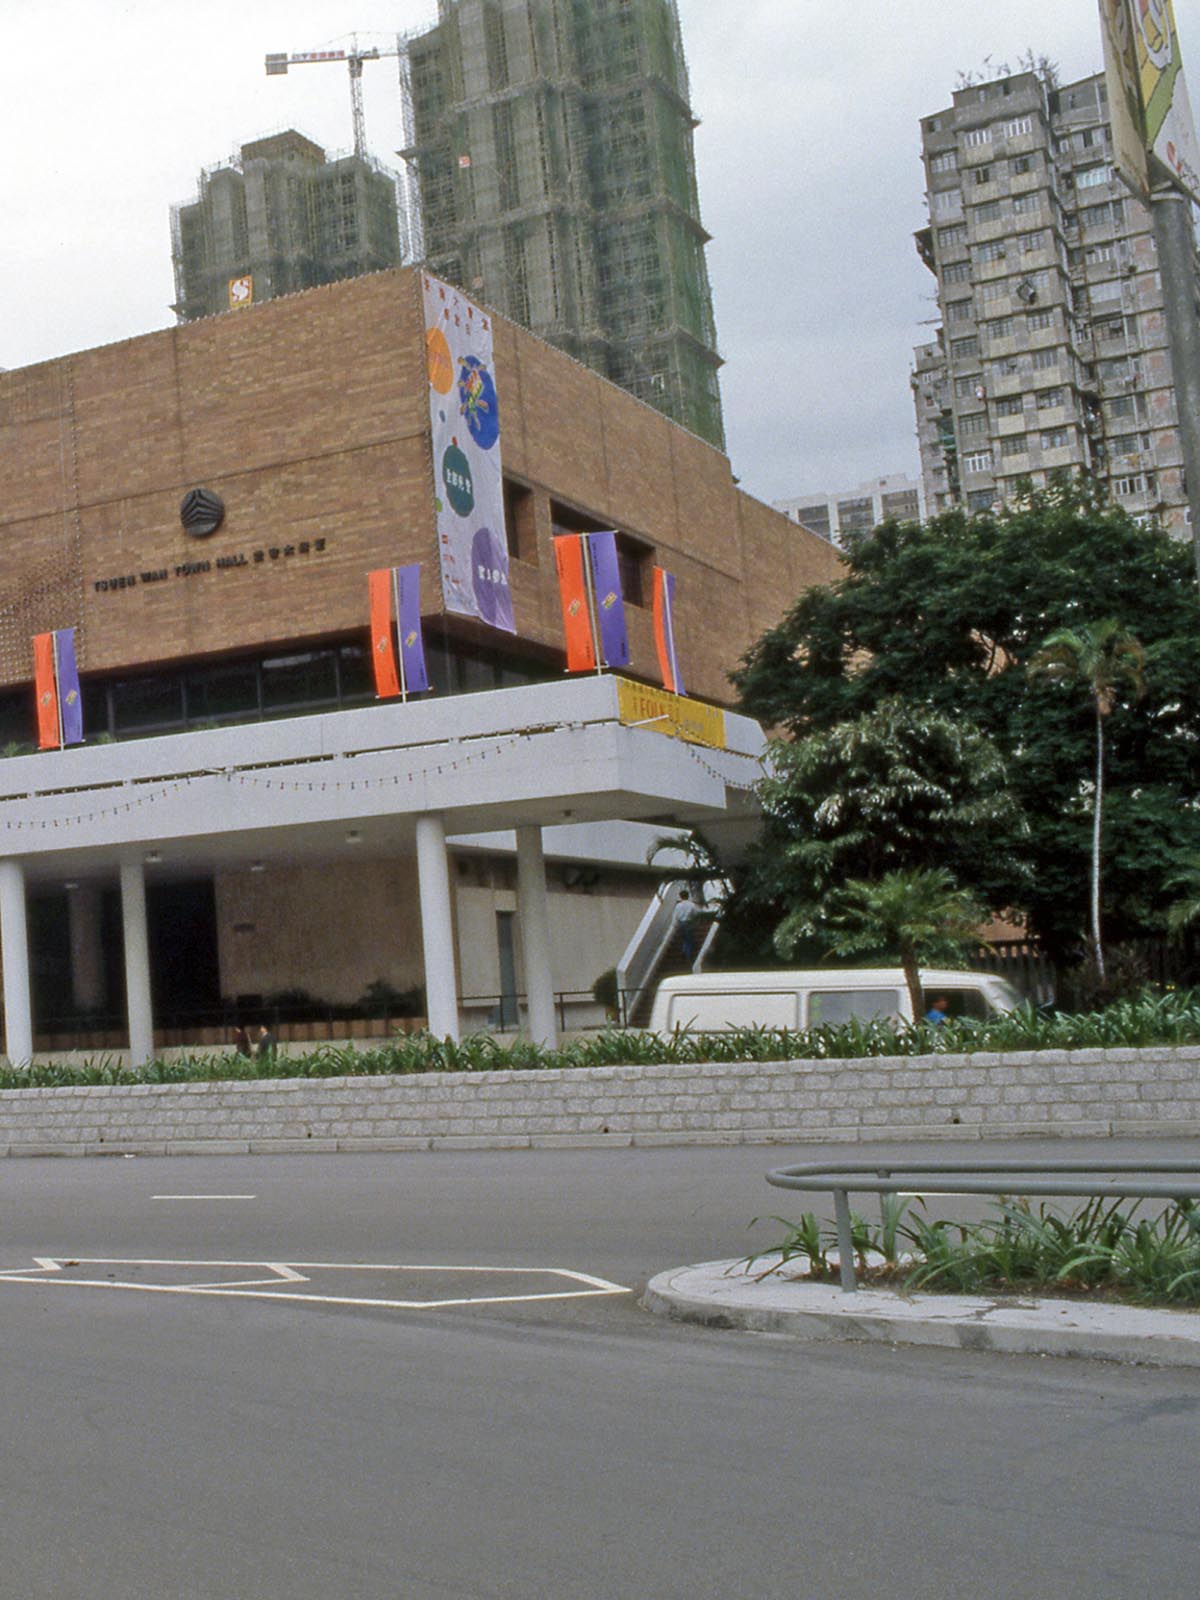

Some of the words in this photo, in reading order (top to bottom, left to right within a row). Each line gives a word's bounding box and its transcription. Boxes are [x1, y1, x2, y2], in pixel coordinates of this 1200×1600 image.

[94, 575, 136, 592] TSUEN
[140, 569, 168, 583] WAN
[175, 560, 211, 577] TOWN
[215, 553, 248, 569] HALL
